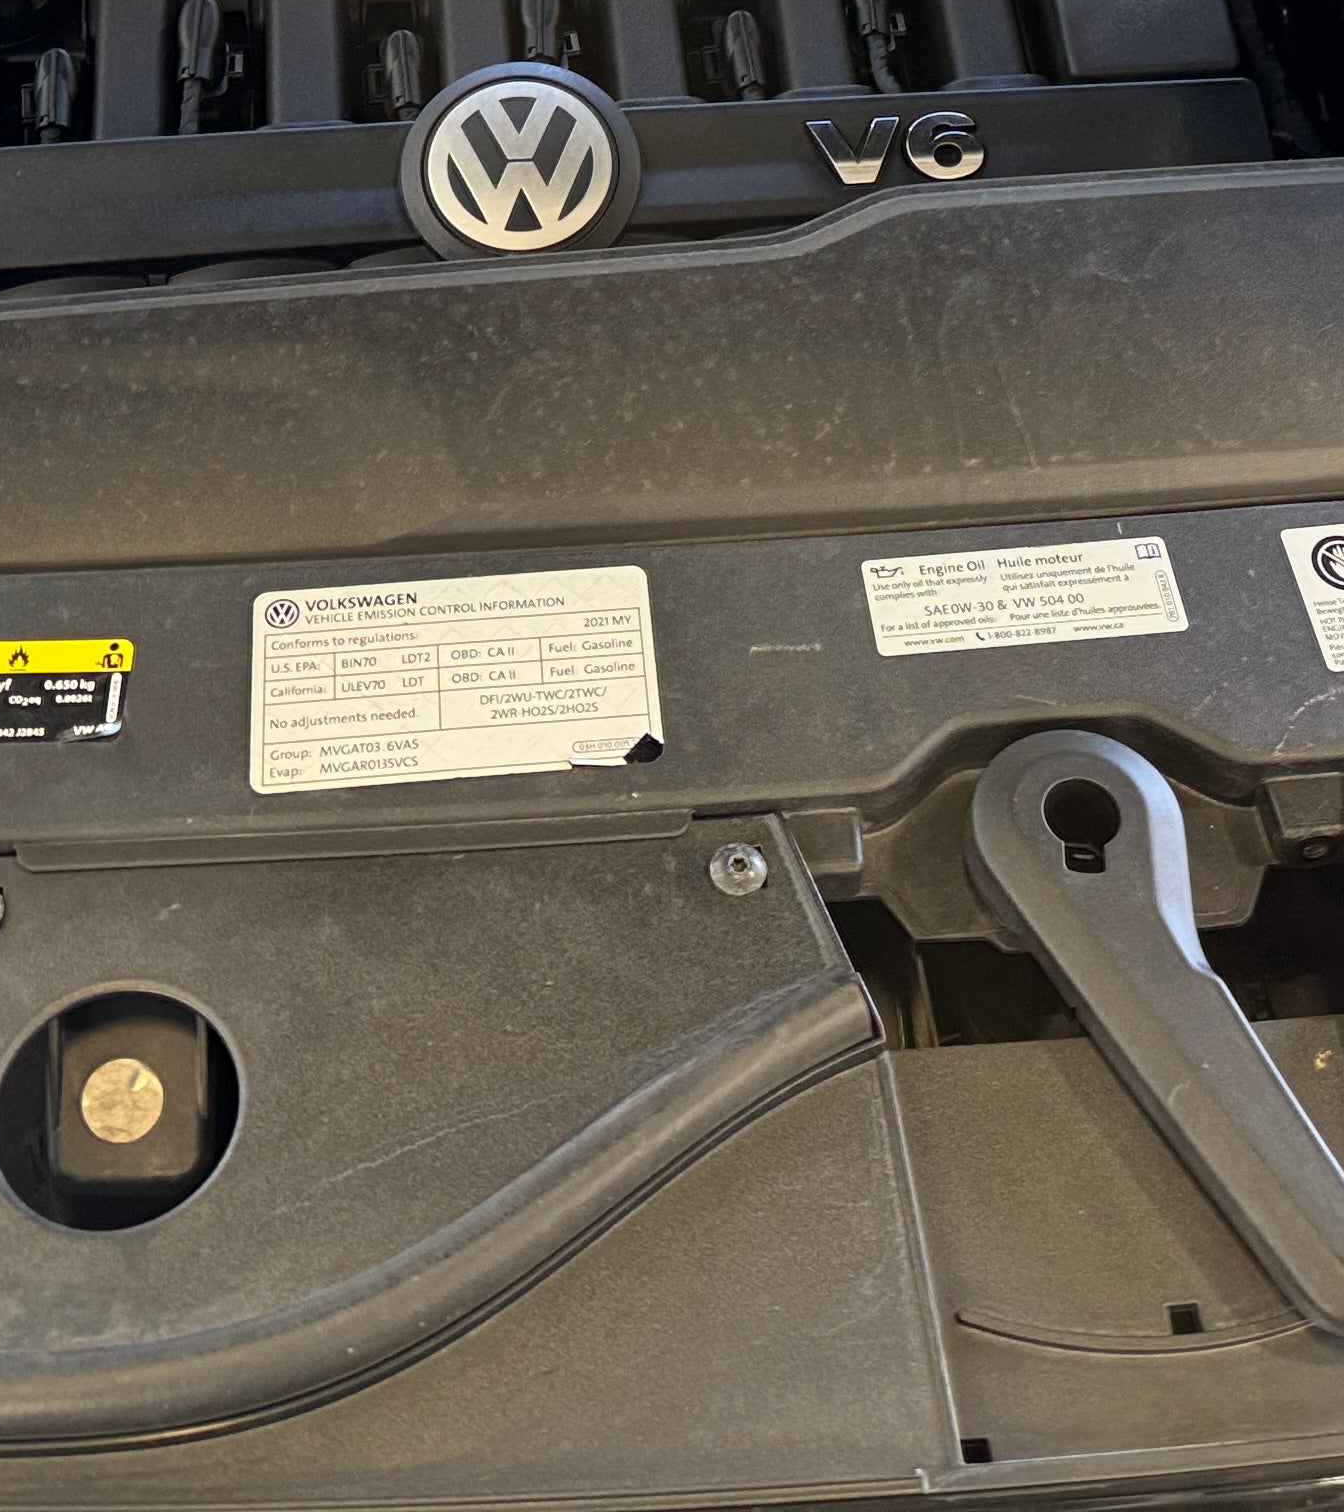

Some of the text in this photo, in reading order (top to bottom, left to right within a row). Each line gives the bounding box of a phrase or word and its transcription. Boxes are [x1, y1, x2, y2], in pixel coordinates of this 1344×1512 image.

[804, 111, 986, 185] V6
[919, 559, 986, 578] Engine Oil
[996, 554, 1083, 569] Huile moteur
[1093, 565, 1106, 574] de
[891, 580, 912, 591] only
[925, 576, 945, 587] that
[305, 593, 417, 612] VOLKSWAGEN
[997, 599, 1008, 611] &
[1012, 597, 1036, 609] VW
[1039, 594, 1065, 607] 504
[1067, 592, 1085, 605] 00
[305, 597, 565, 625] VEHICLE EMISSION CONTROL INFORMATION
[1009, 613, 1031, 621] Pour
[1032, 612, 1050, 620] une
[1050, 609, 1070, 618] liste
[584, 615, 632, 628] 2021 MY
[880, 616, 977, 633] For list of approved
[271, 638, 330, 651] Conforms
[332, 636, 346, 647] to
[581, 638, 633, 651] Gasoline
[487, 647, 506, 658] CA
[341, 652, 431, 669] BIN70 LDT2
[583, 661, 636, 675] Gasoline
[488, 670, 507, 681] CA
[79, 678, 96, 692] kg
[341, 676, 425, 693] ULEV70 LDT
[480, 686, 607, 706] DFI/2WU-TWC/2TWC/
[270, 707, 418, 730] No adjustments needed.
[491, 702, 599, 720] 2WR-HO2S/2HO2S
[73, 725, 95, 735] VW
[270, 749, 312, 761] Group:
[269, 756, 419, 779] Evap: MVGAR0135VCS
